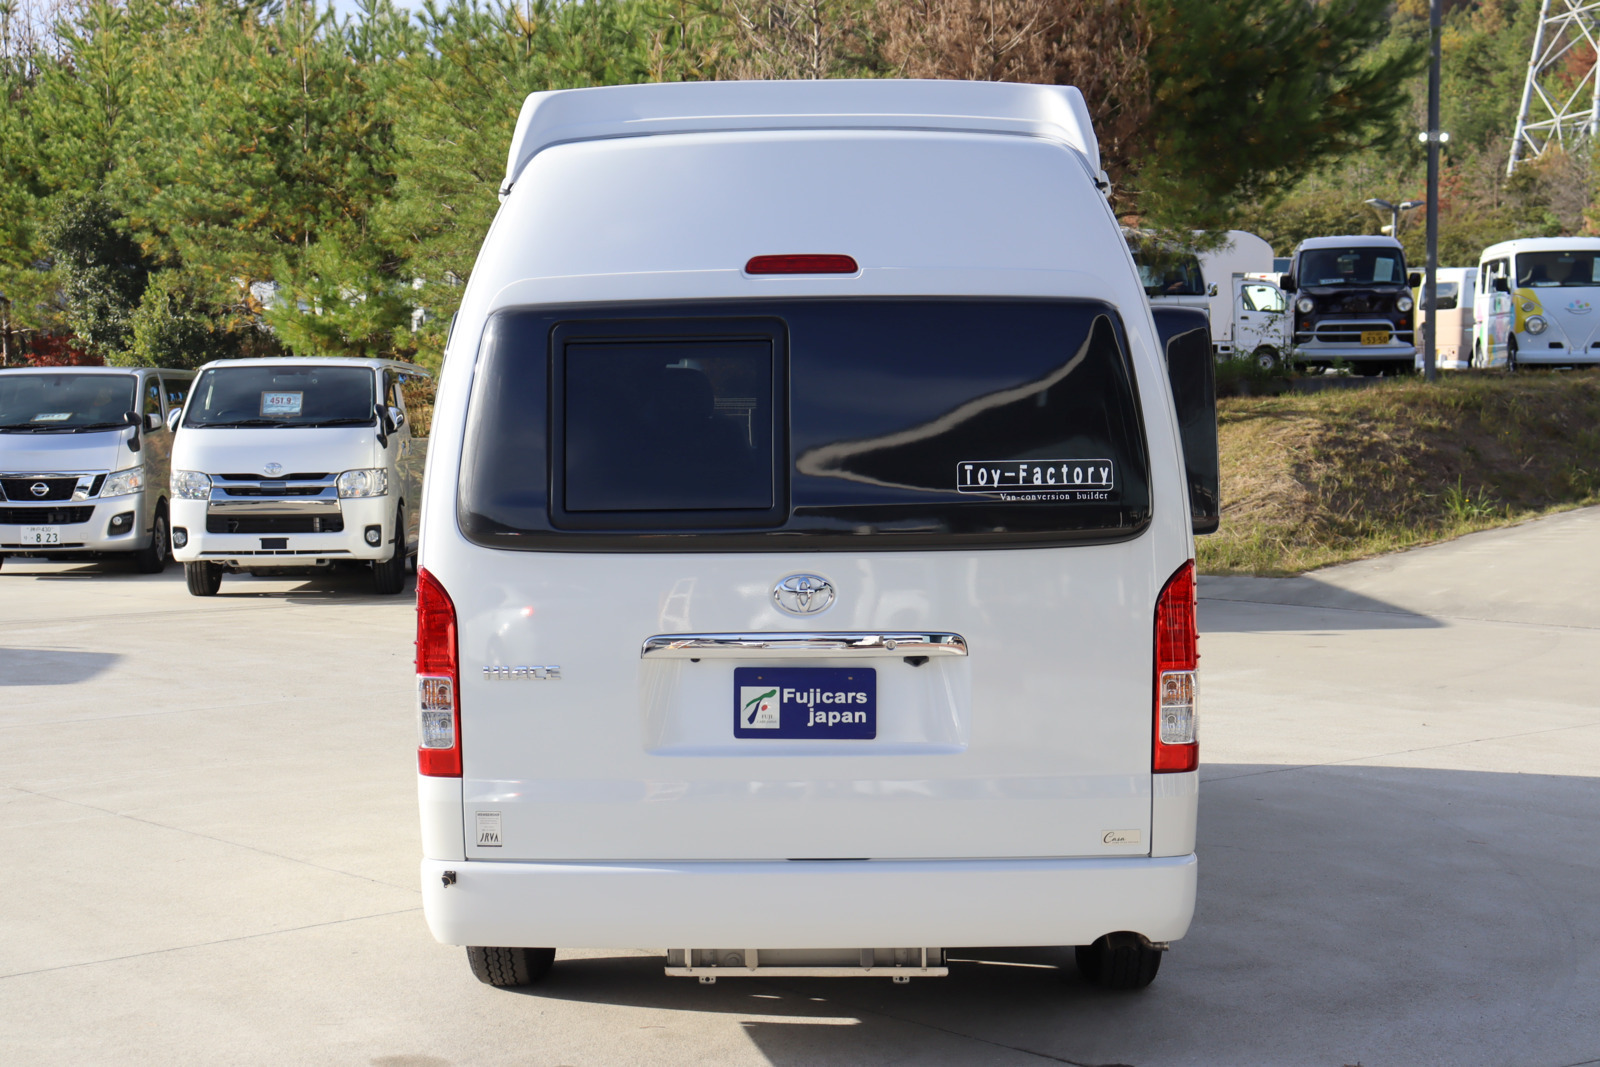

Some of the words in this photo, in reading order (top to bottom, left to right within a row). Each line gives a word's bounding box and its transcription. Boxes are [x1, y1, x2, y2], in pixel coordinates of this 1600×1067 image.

[964, 464, 1109, 487] Toy-Factory
[1000, 493, 1070, 501] Van-conversion
[1076, 492, 1108, 500] builder
[482, 666, 561, 681] HIACE
[782, 688, 868, 707] Fujicars
[807, 708, 867, 727] japan
[479, 832, 499, 843] JRVA
